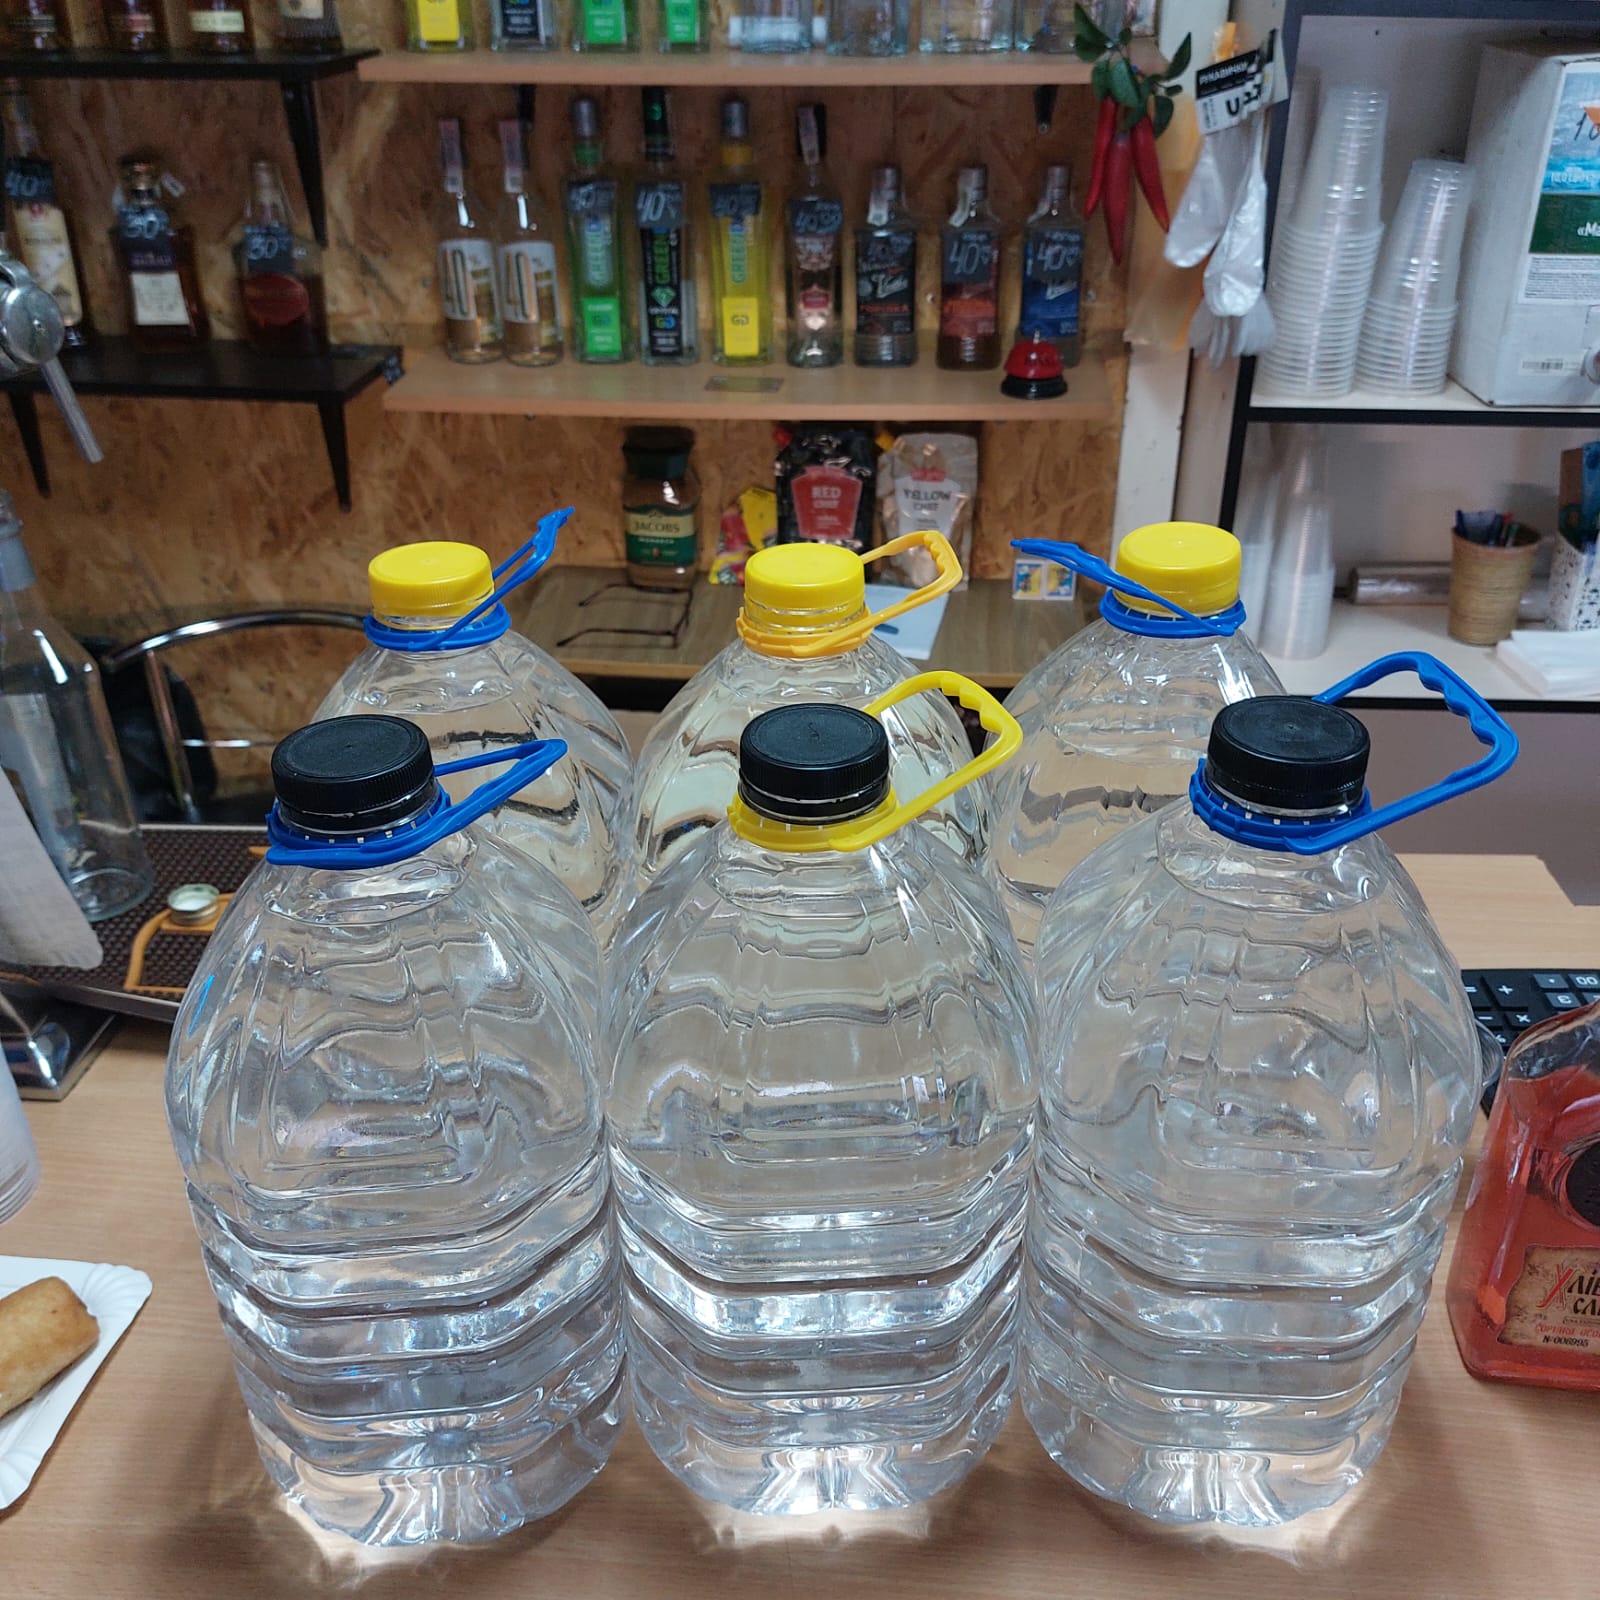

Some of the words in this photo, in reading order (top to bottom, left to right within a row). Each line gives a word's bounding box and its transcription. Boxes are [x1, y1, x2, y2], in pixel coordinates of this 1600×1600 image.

[811, 487, 841, 499] RED
[903, 488, 949, 501] YELLOW
[634, 520, 680, 534] JACOBS
